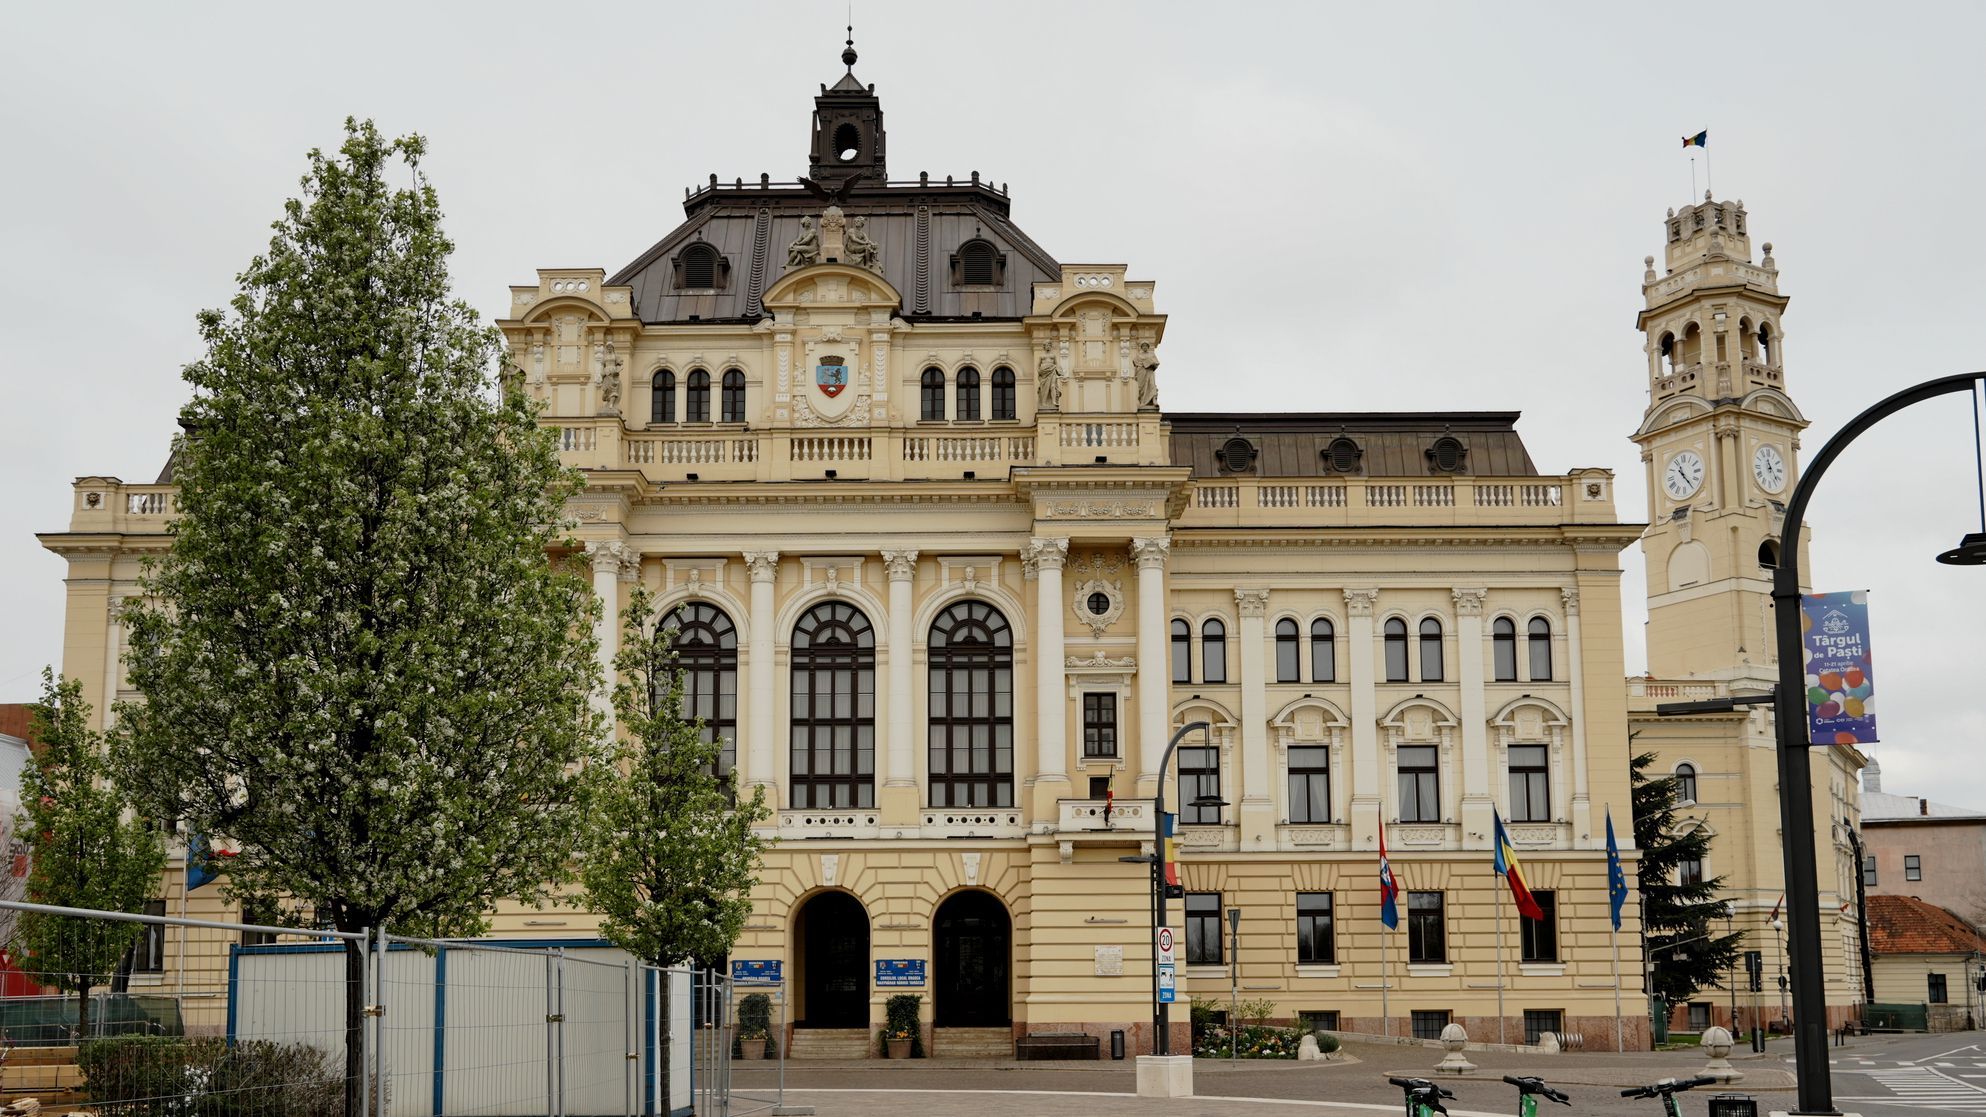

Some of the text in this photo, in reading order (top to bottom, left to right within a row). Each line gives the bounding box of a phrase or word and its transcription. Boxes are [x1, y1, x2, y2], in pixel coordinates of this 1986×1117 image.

[1812, 633, 1861, 647] Târgul
[1827, 645, 1862, 659] Paști
[1162, 935, 1169, 945] 20
